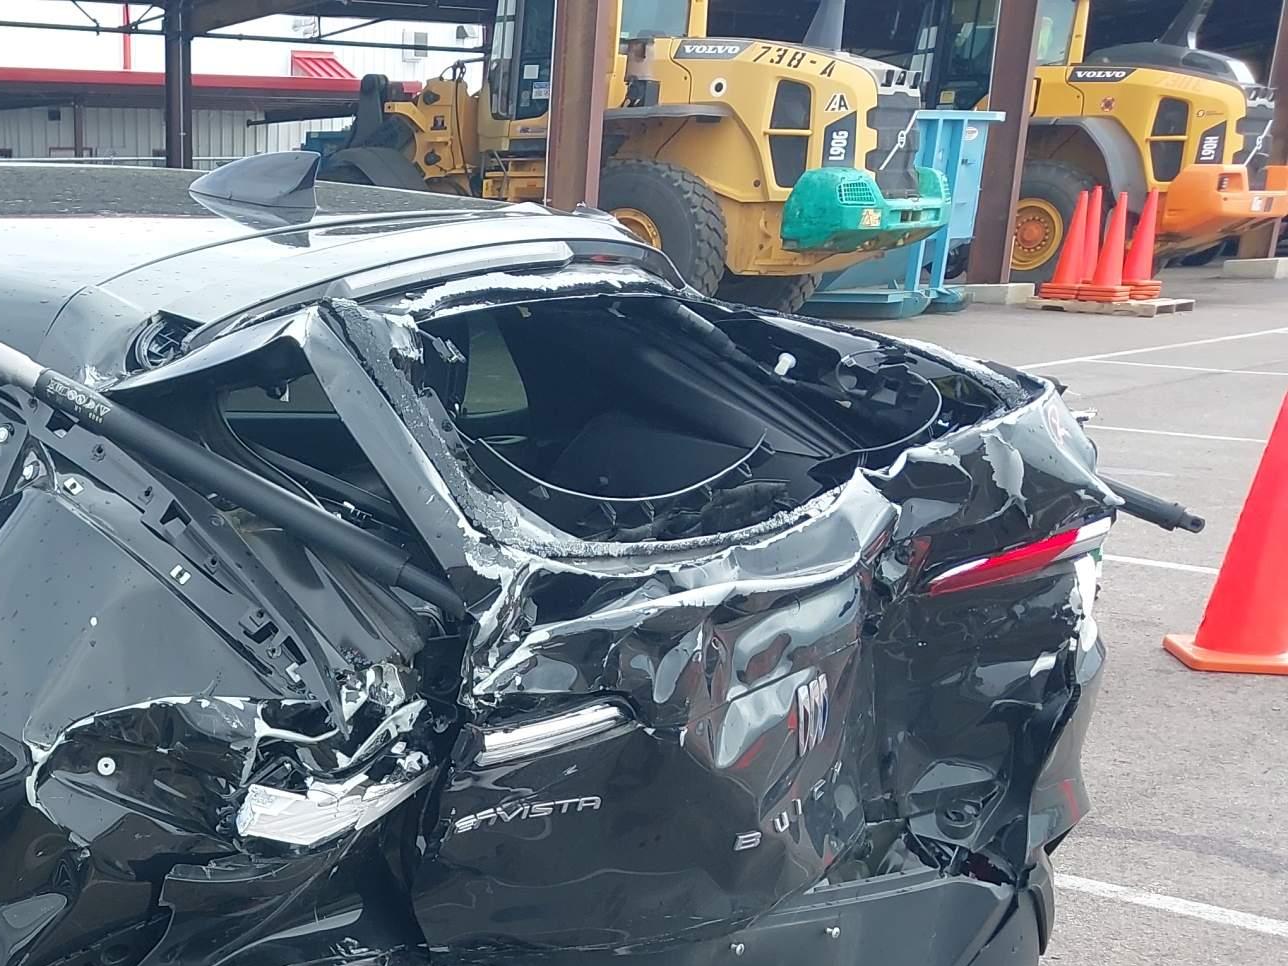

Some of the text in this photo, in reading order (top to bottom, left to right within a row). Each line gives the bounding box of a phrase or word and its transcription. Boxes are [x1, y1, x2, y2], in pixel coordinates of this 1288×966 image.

[683, 44, 741, 55] VOLVO
[1075, 70, 1127, 79] VOLVO
[828, 130, 849, 161] L90G
[1200, 135, 1220, 161] L90H
